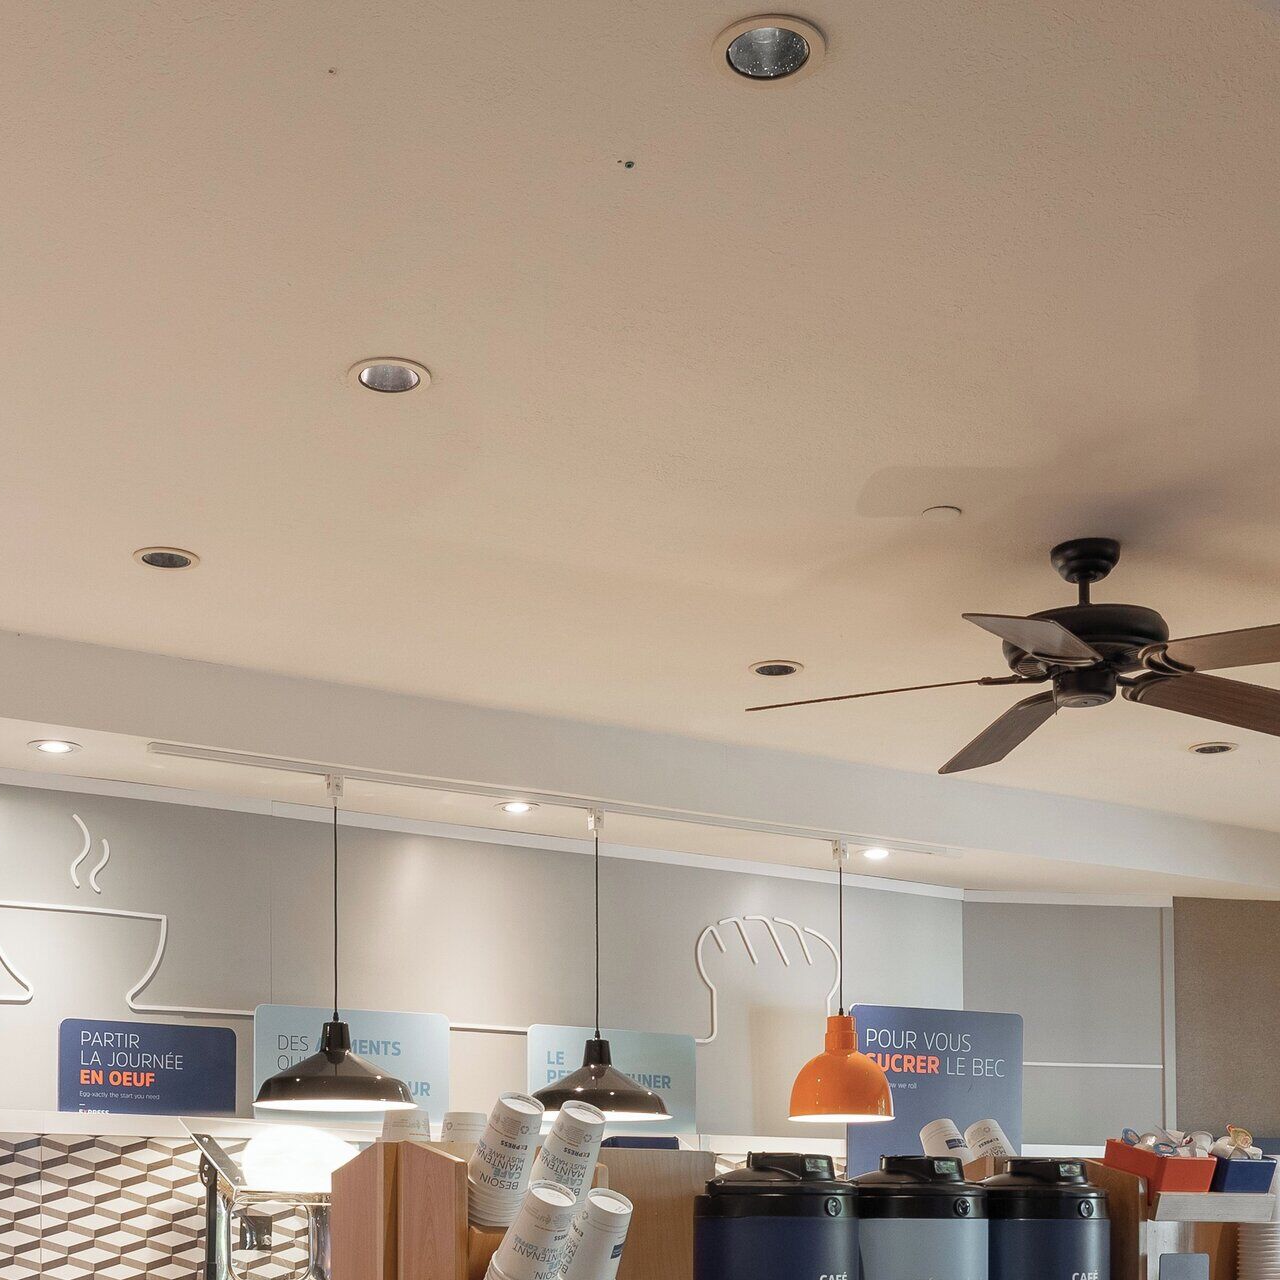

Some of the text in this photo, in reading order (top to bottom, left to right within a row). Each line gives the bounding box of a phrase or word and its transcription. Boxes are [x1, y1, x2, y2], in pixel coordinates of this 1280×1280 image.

[80, 1030, 141, 1049] PARTIR
[277, 1034, 309, 1052] DES
[866, 1028, 972, 1052] POUR VOUS
[80, 1050, 184, 1070] LA JOURNÉE
[546, 1051, 565, 1065] LE
[946, 1057, 966, 1076] LE
[972, 1058, 1006, 1078] BEC
[79, 1069, 155, 1087] EN OEUF
